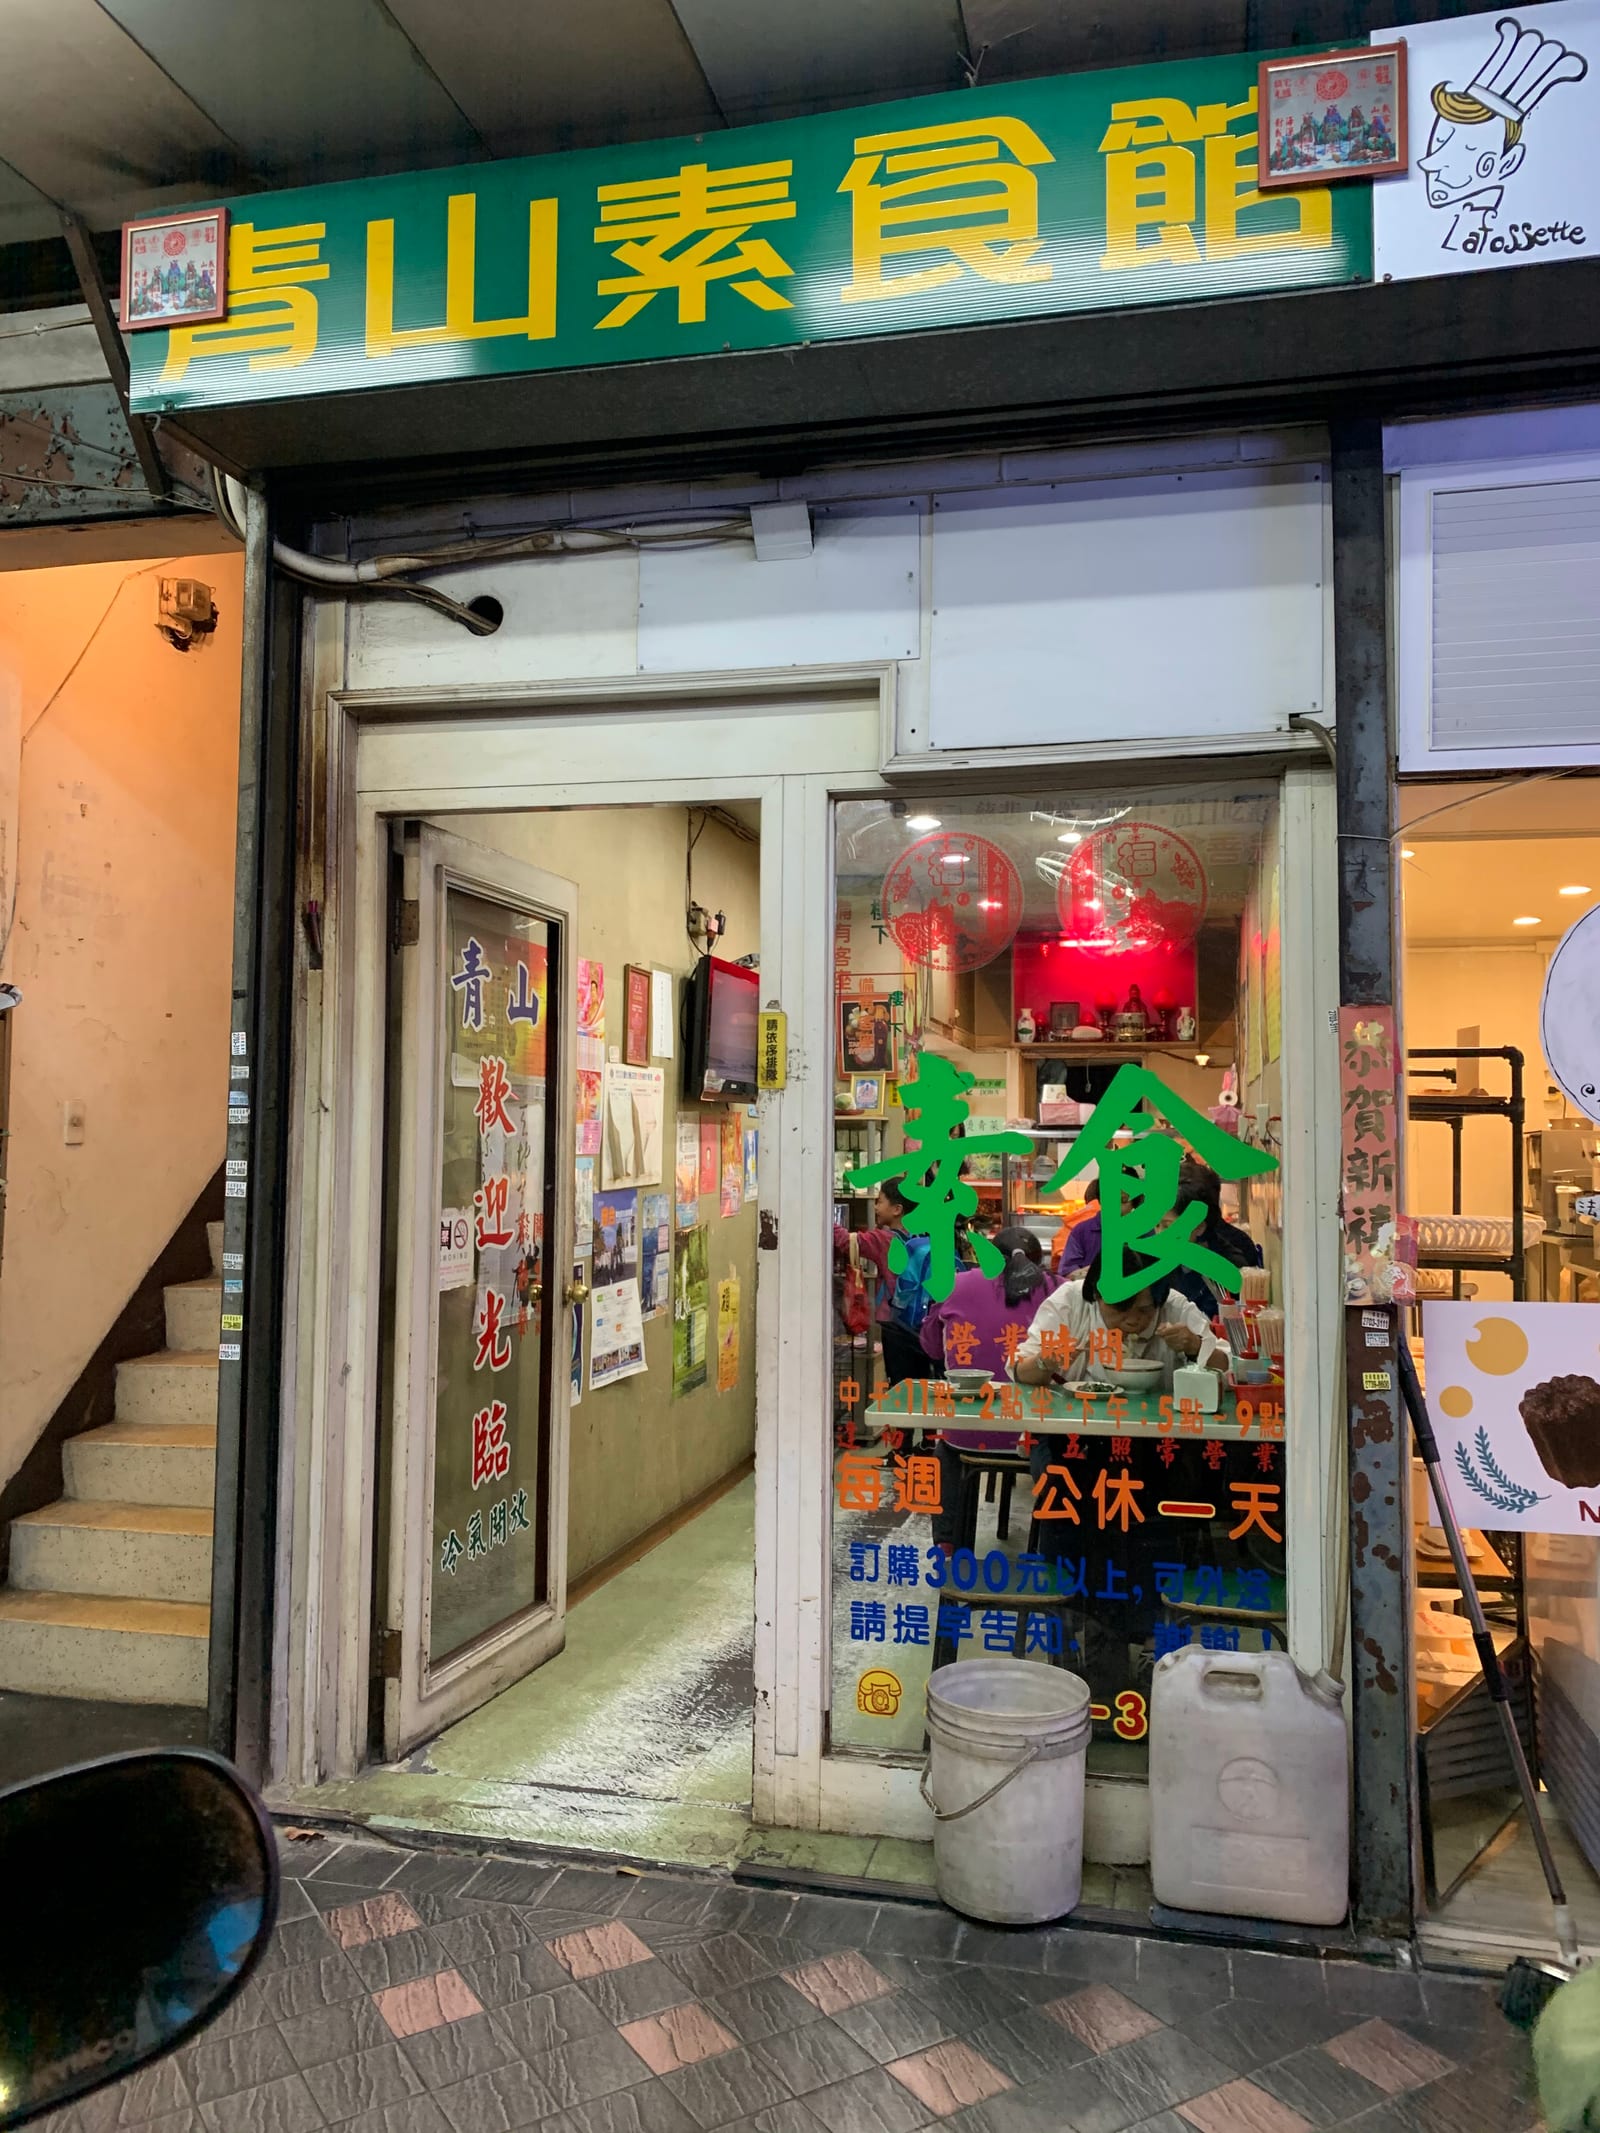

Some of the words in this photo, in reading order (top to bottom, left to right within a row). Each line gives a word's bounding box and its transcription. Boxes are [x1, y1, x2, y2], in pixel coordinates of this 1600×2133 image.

[158, 87, 1332, 382] 青山素食館
[452, 938, 540, 1032] 青山
[766, 1019, 778, 1082] 請依序排隊
[846, 1051, 1280, 1304] 素食
[1344, 1020, 1396, 1254] 恭賀新禧
[1579, 1199, 1597, 1218] 法
[472, 1055, 516, 1490] 歡迎光臨
[947, 1323, 1124, 1371] 營業時間
[441, 1488, 530, 1575] 冷氣開放
[835, 1453, 944, 1515] 每週
[1032, 1464, 1283, 1543] 公休一天
